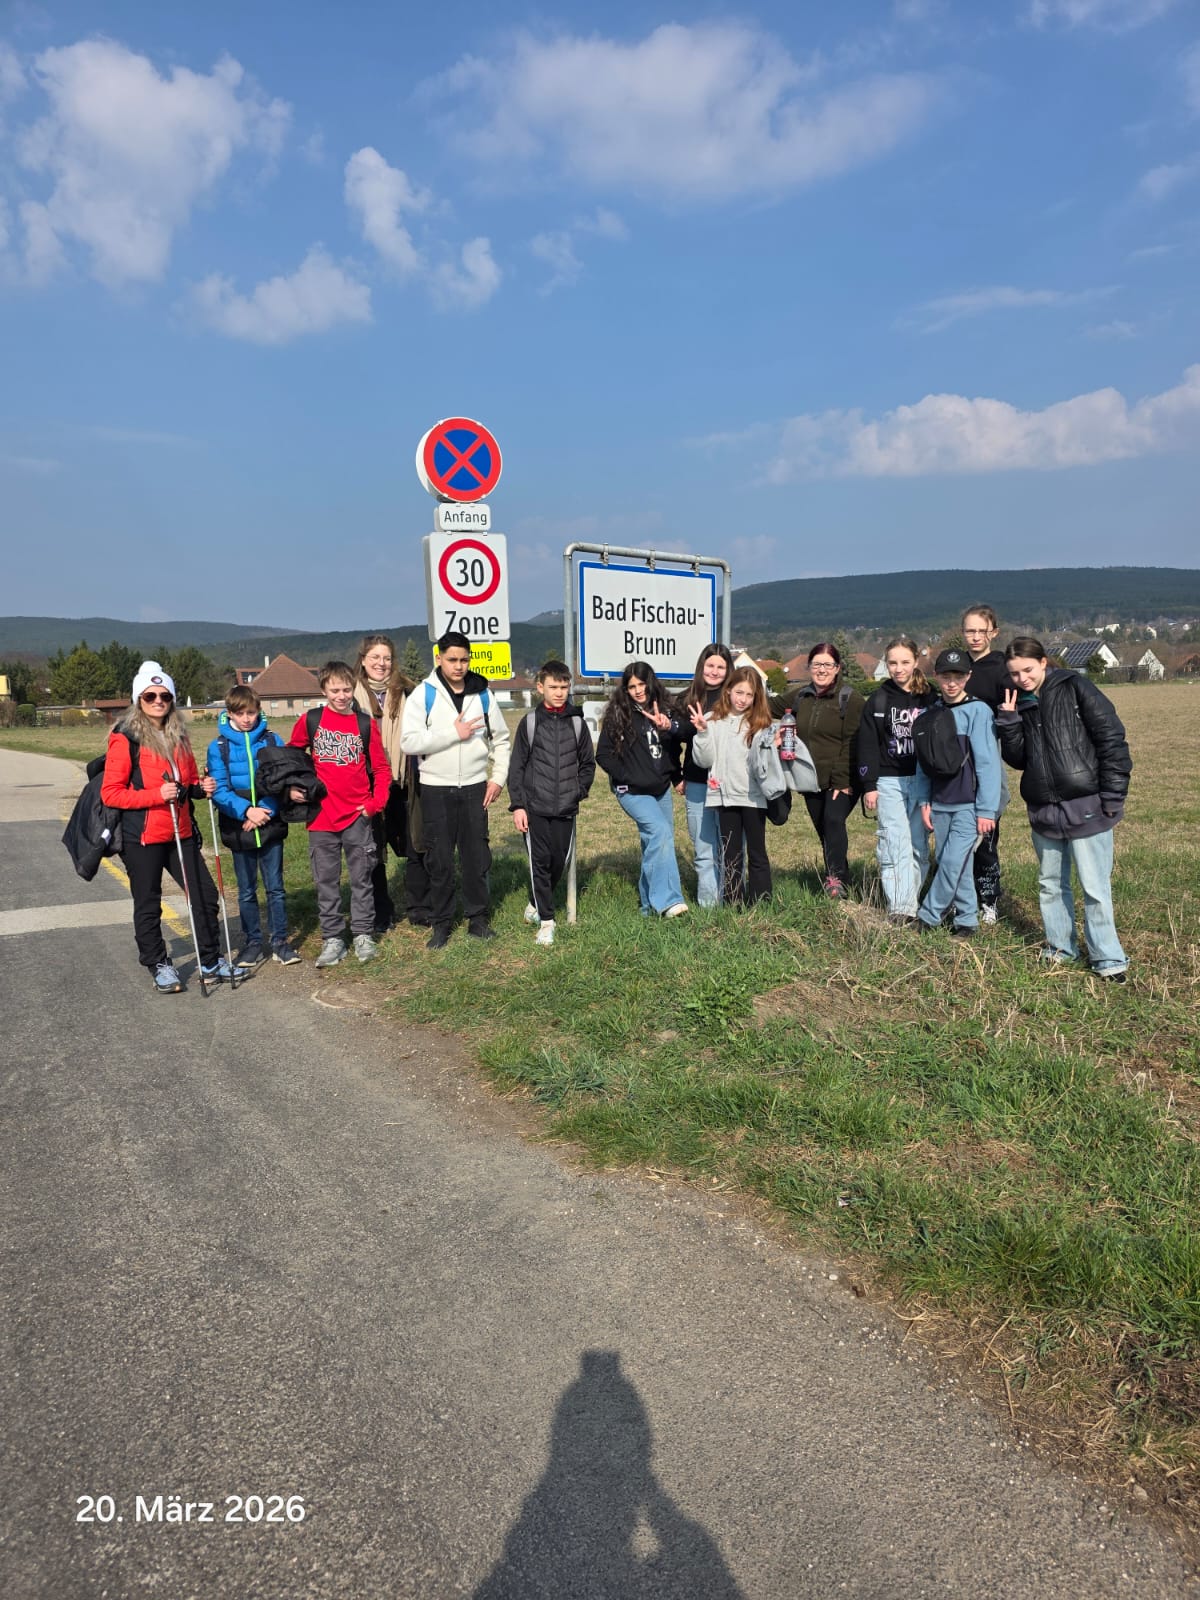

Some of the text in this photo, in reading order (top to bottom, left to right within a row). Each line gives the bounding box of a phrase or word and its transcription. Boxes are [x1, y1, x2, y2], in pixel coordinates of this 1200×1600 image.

[444, 510, 487, 525] Anfang
[455, 558, 485, 588] 30
[592, 595, 705, 625] Bad Fischau-
[445, 611, 500, 635] Zone
[470, 650, 493, 661] tung
[624, 630, 676, 656] Brunn
